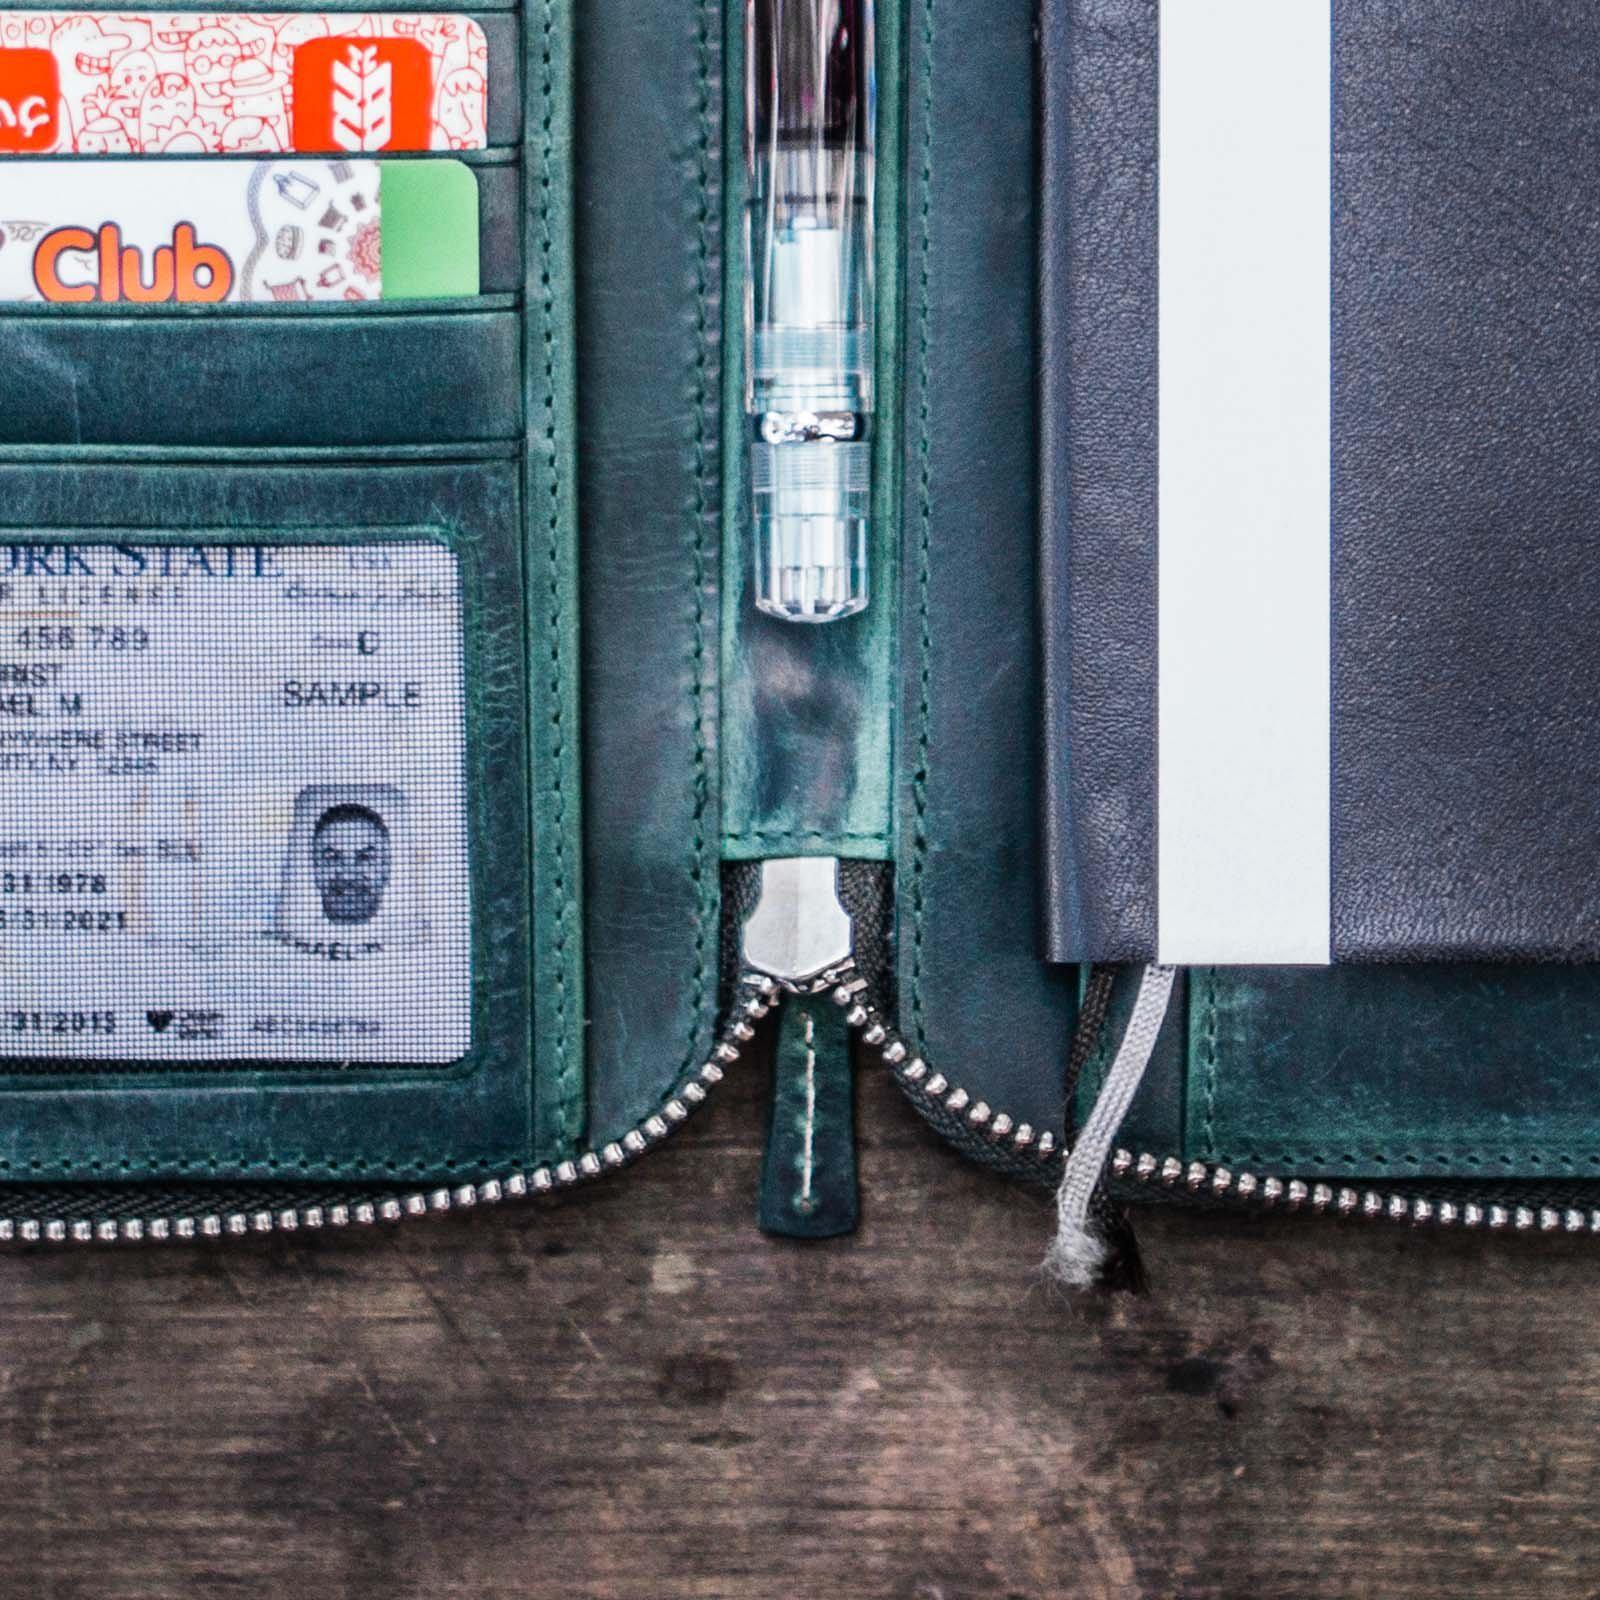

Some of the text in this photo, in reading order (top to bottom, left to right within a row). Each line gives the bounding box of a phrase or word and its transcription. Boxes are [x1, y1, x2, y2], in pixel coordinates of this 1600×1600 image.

[31, 220, 234, 302] Club
[111, 545, 285, 579] STATE
[283, 681, 423, 707] SAMPLE
